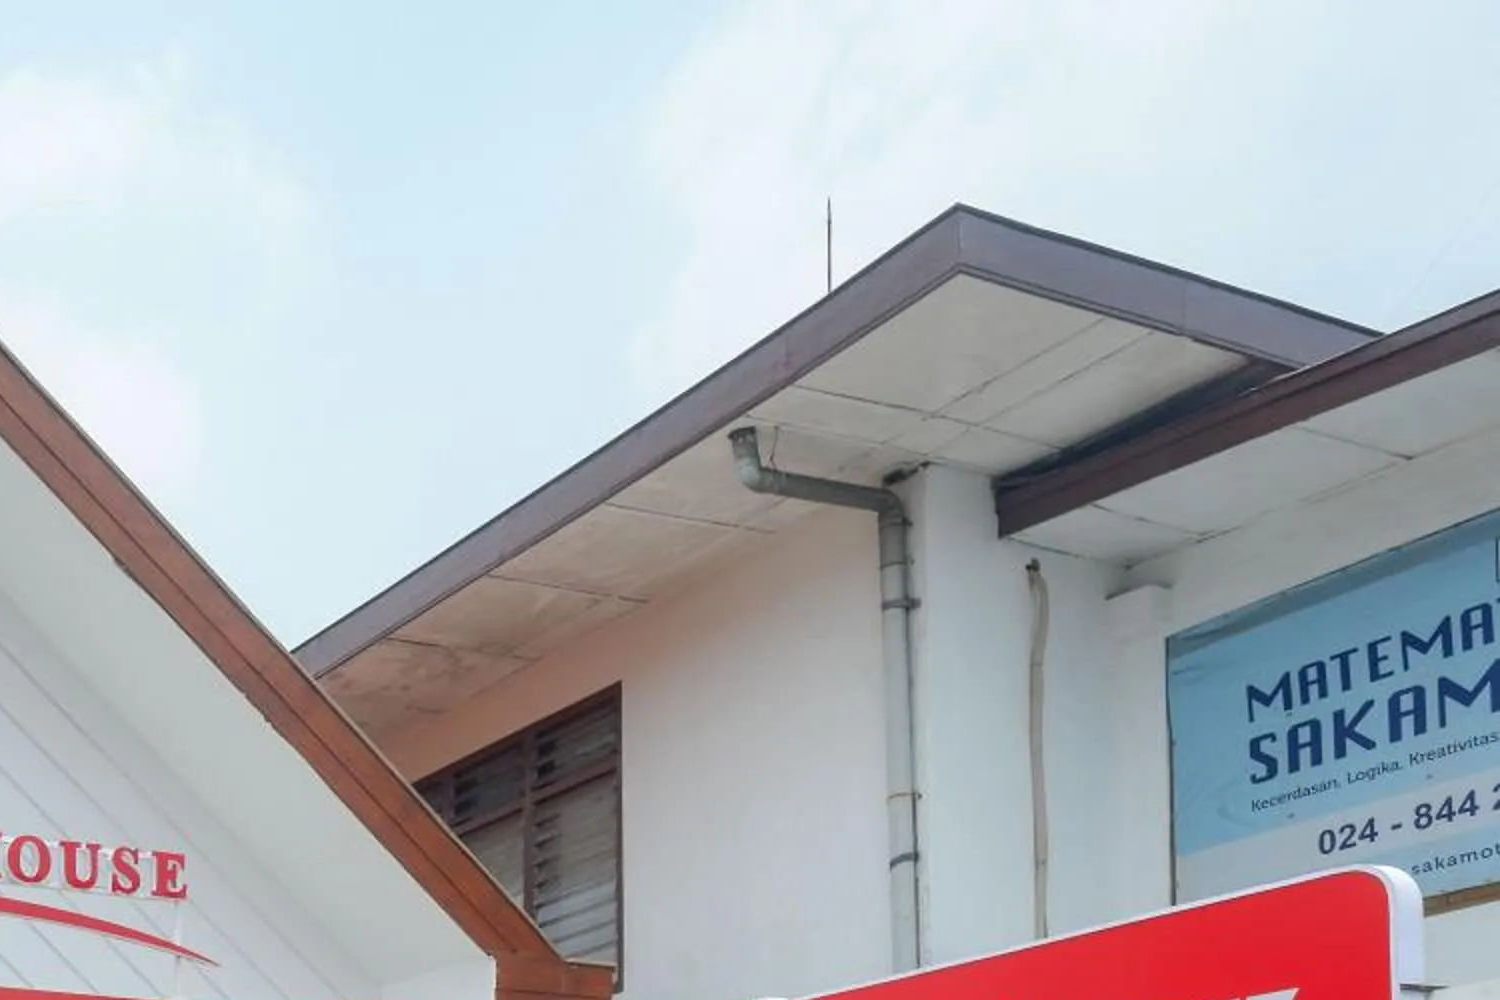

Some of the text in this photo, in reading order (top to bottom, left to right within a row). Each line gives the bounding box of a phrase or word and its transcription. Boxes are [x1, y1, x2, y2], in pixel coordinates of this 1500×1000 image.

[1246, 597, 1500, 723] MATEMA
[1249, 658, 1500, 784] SAKAM
[1318, 816, 1379, 855] 024
[1413, 788, 1480, 830] 844
